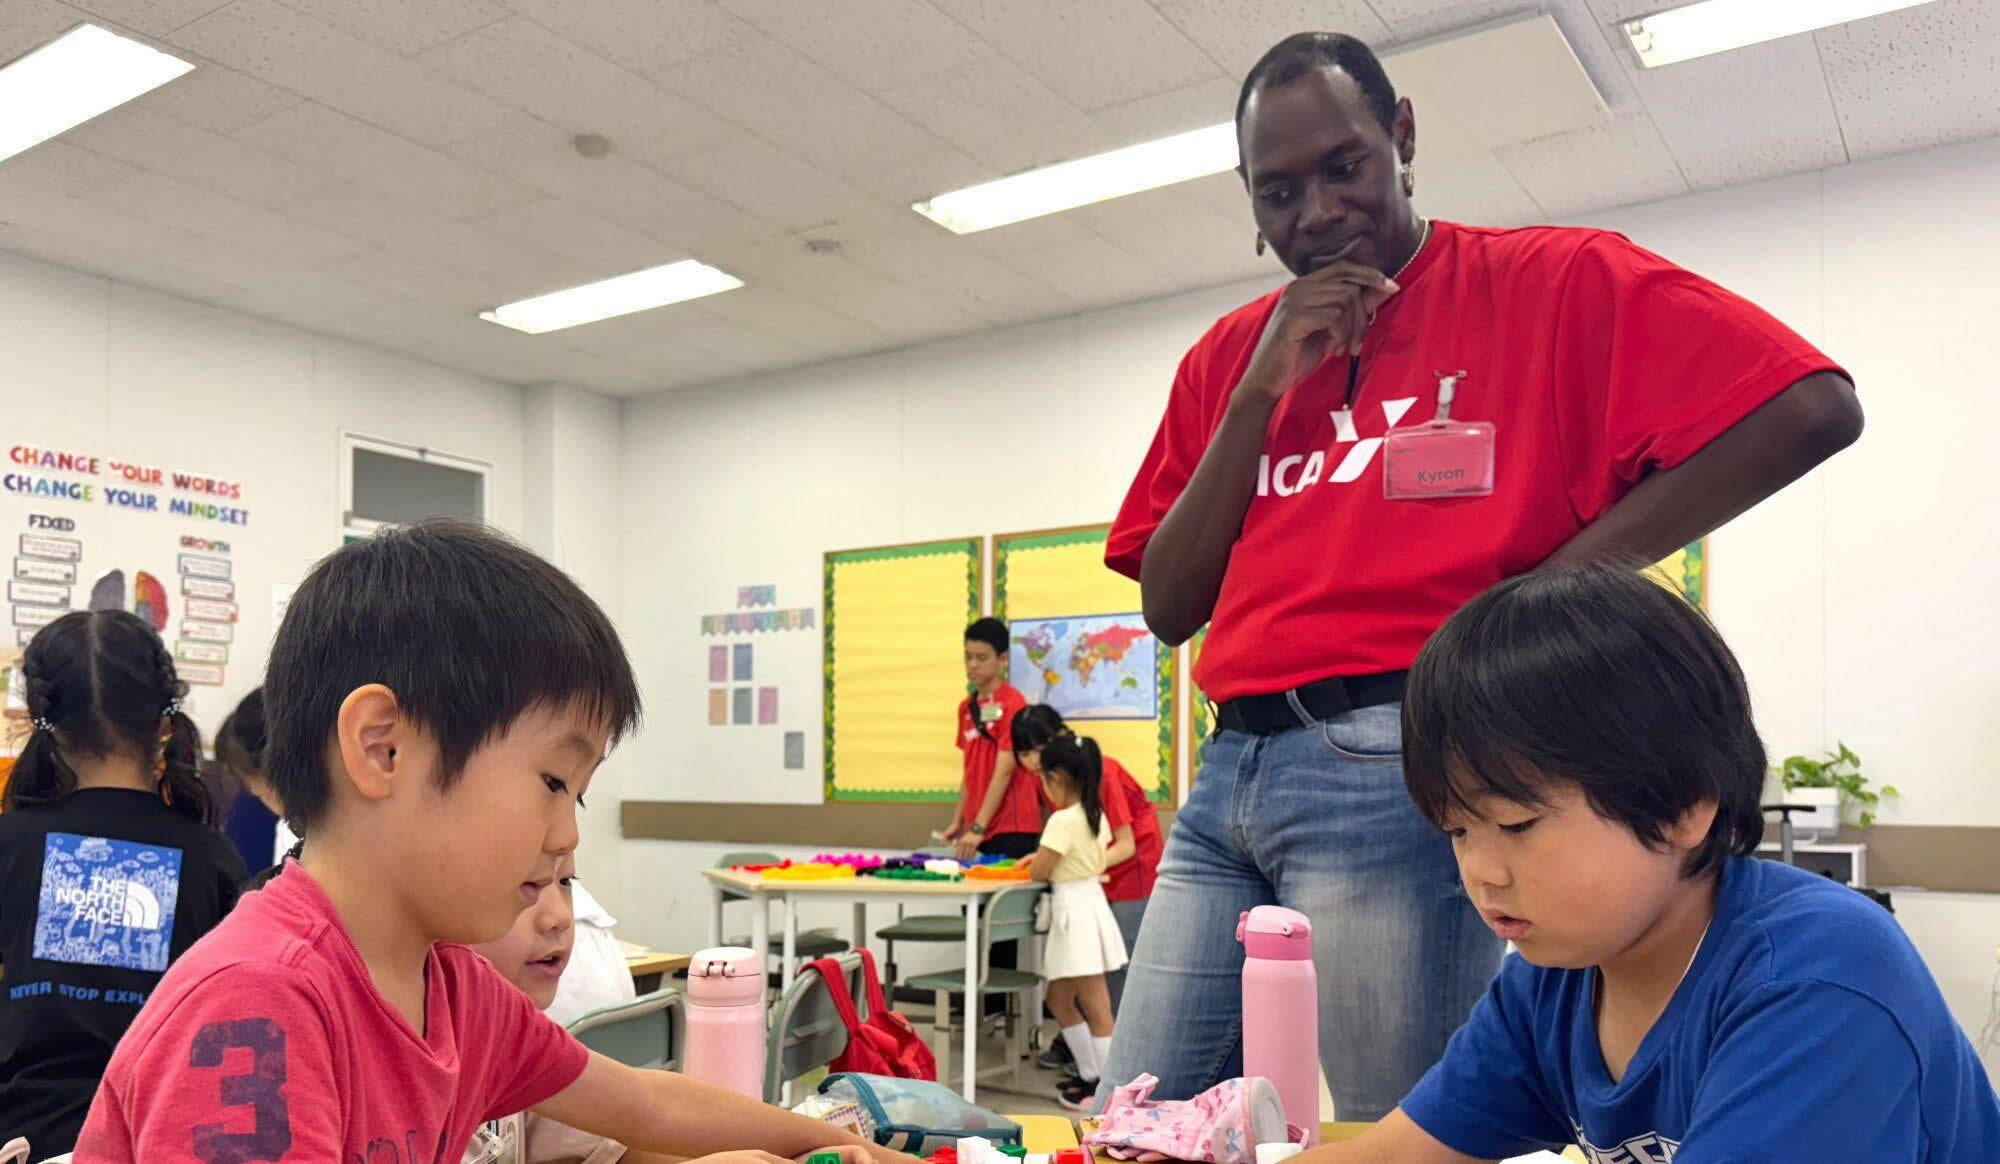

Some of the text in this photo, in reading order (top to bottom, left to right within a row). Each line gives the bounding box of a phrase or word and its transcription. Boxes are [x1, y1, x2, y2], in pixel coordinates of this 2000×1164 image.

[10, 446, 100, 475] CHANGE
[172, 472, 241, 500] WORDS
[1417, 467, 1465, 483] Kyron
[4, 473, 249, 526] CHANGE YOUR MINDSET
[29, 513, 76, 532] FIXED
[179, 535, 231, 553] GROWTH
[90, 876, 128, 895] THE
[56, 888, 126, 911] NORTH
[75, 905, 124, 926] FACE
[59, 983, 99, 1001] STOP
[189, 1017, 292, 1163] 3
